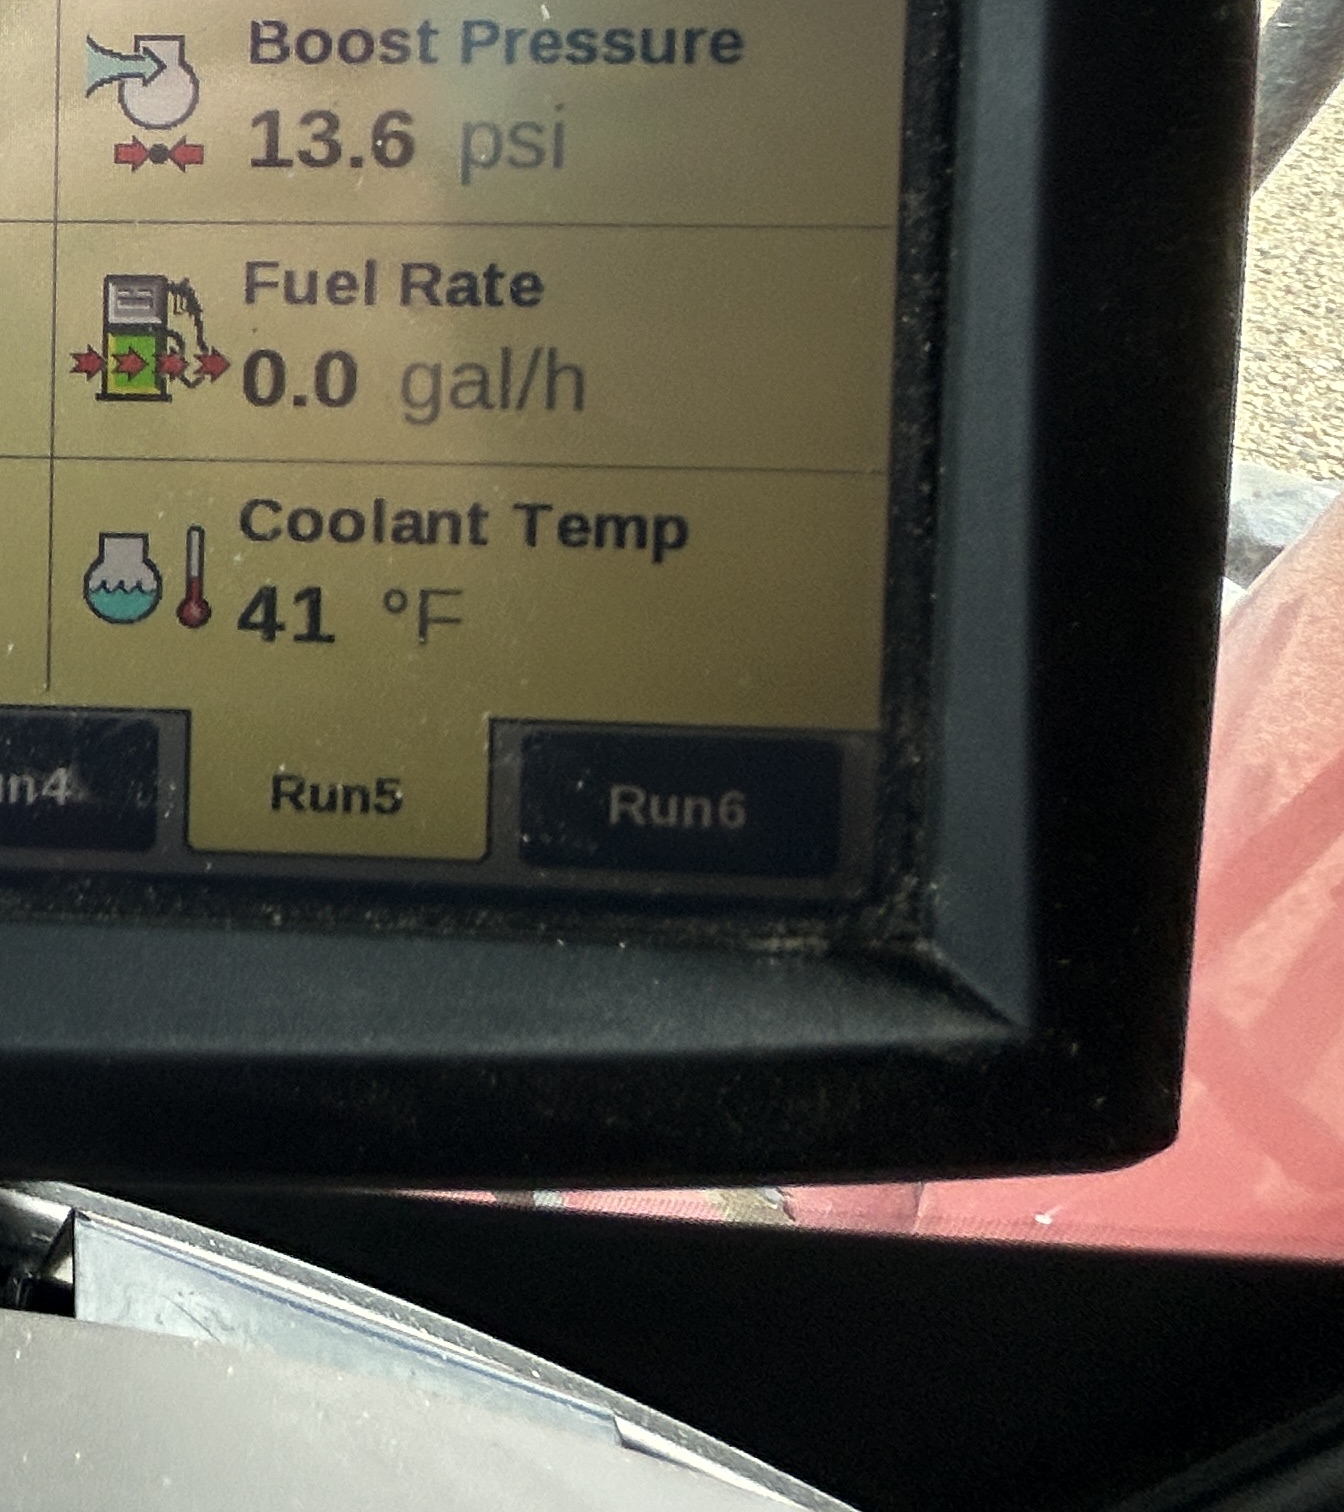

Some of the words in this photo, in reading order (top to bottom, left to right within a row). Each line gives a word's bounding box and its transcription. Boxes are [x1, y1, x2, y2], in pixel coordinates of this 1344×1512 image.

[250, 19, 440, 65] Boost
[461, 19, 745, 65] Pressure
[250, 108, 415, 169] 13.6
[461, 102, 565, 186] psi
[244, 259, 377, 306] Fuel
[399, 261, 544, 307] Rate
[242, 349, 357, 408] 0.0
[400, 346, 586, 425] gal/h
[240, 498, 489, 546] Coolant
[513, 501, 689, 563] Temp
[237, 586, 335, 643] 41
[382, 588, 463, 645] °F
[270, 773, 404, 819] Run5
[607, 785, 747, 831] Run6
